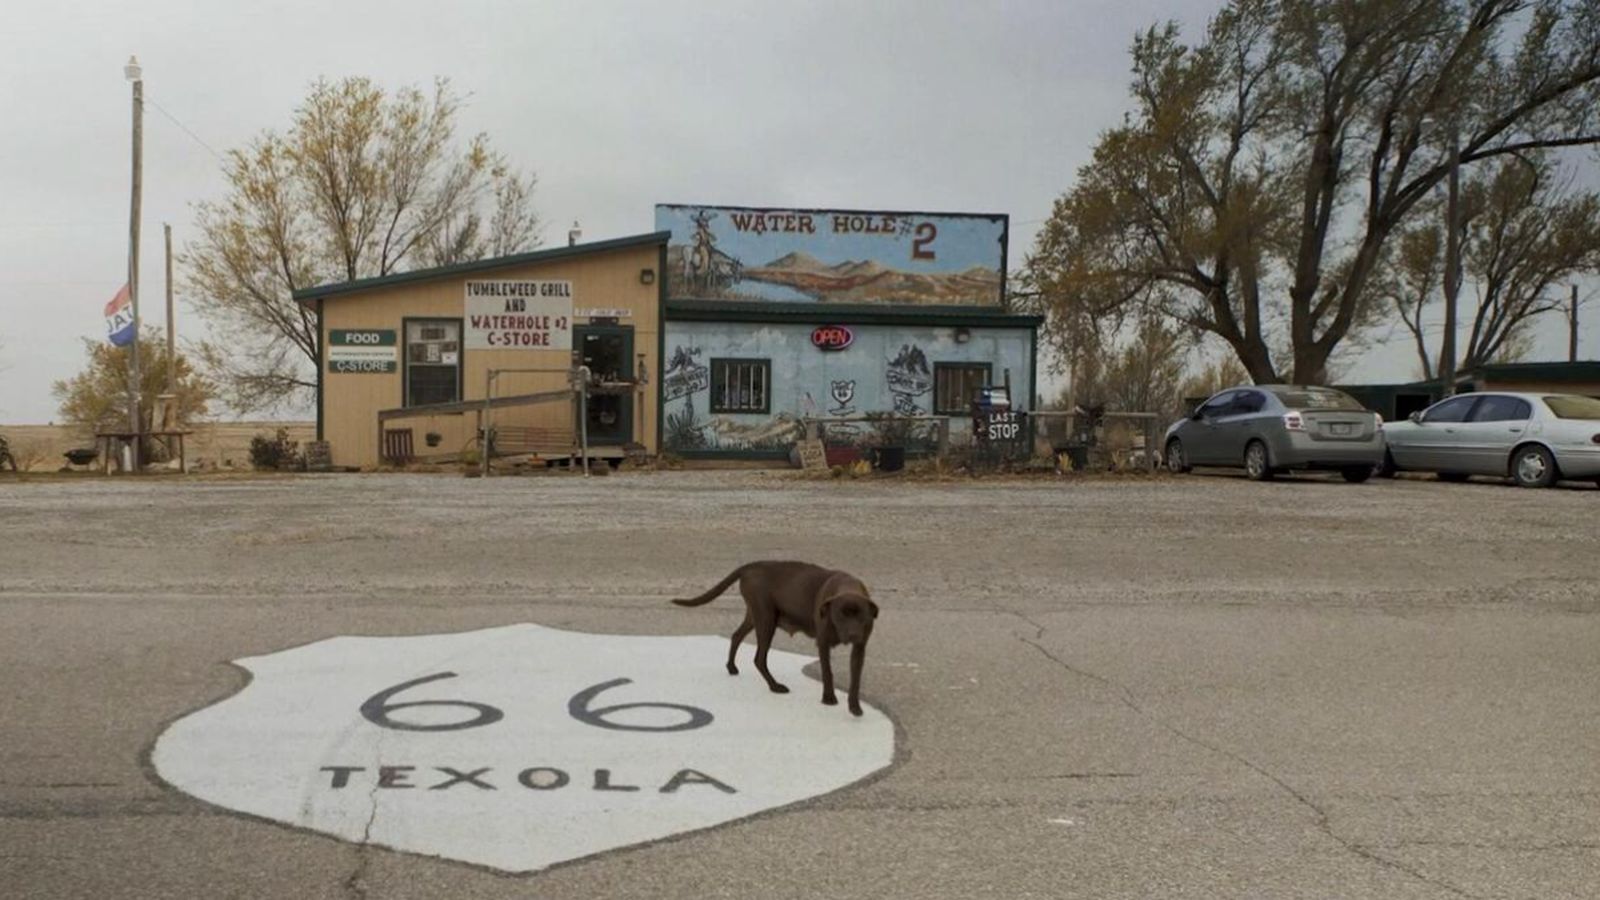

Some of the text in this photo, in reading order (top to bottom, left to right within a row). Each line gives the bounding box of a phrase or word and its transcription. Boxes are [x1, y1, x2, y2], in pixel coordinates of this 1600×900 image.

[731, 213, 816, 234] WATER
[832, 215, 897, 233] HOLE
[467, 282, 570, 297] TUMBLEWEED GRILL
[505, 299, 526, 312] AND
[471, 315, 549, 330] WATERHOLE
[345, 333, 380, 344] FOOD
[487, 331, 549, 346] C-STORE
[814, 329, 846, 344] OPEN
[336, 360, 389, 371] C-STORE
[989, 412, 1017, 423] LAST
[988, 423, 1020, 440] STOP
[360, 671, 714, 732] 66
[318, 764, 738, 794] TEXOLA
